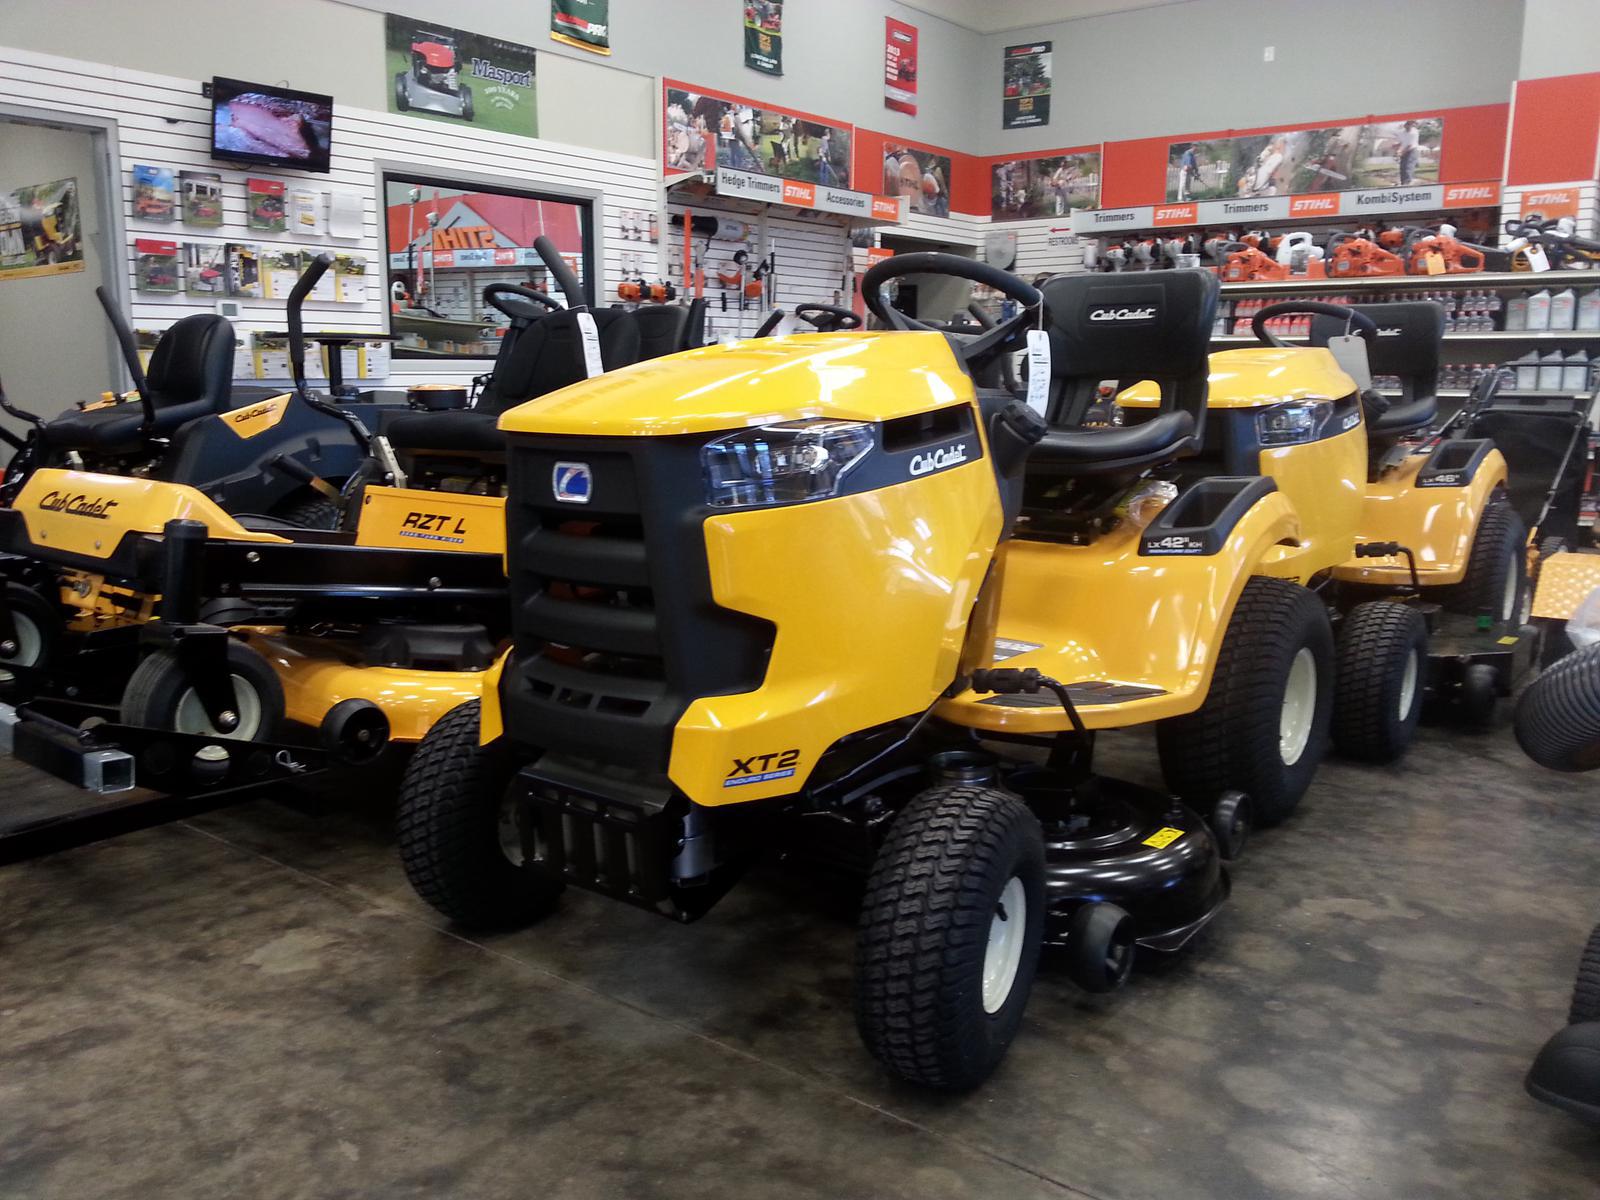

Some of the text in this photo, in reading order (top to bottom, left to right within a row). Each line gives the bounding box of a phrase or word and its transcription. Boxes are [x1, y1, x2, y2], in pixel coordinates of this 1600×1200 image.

[471, 58, 532, 88] Masport
[722, 172, 780, 193] Hedge Trimmers
[784, 185, 812, 200] STIHL
[826, 191, 865, 208] Accessories
[1357, 192, 1432, 205] KombiSystem
[1447, 187, 1493, 201] STIHL
[1527, 193, 1570, 206] STIHL
[872, 201, 897, 214] STIHL
[1223, 203, 1269, 214] Trimmers
[1292, 199, 1334, 211] STIHL
[1094, 213, 1136, 223] Trimmers
[1155, 208, 1193, 220] STIHL
[1090, 308, 1156, 321] Cub Cadet
[910, 444, 967, 476] Cub Cadet
[39, 491, 118, 519] Cub Cadet
[402, 512, 466, 534] RZT L
[727, 749, 800, 777] XT2
